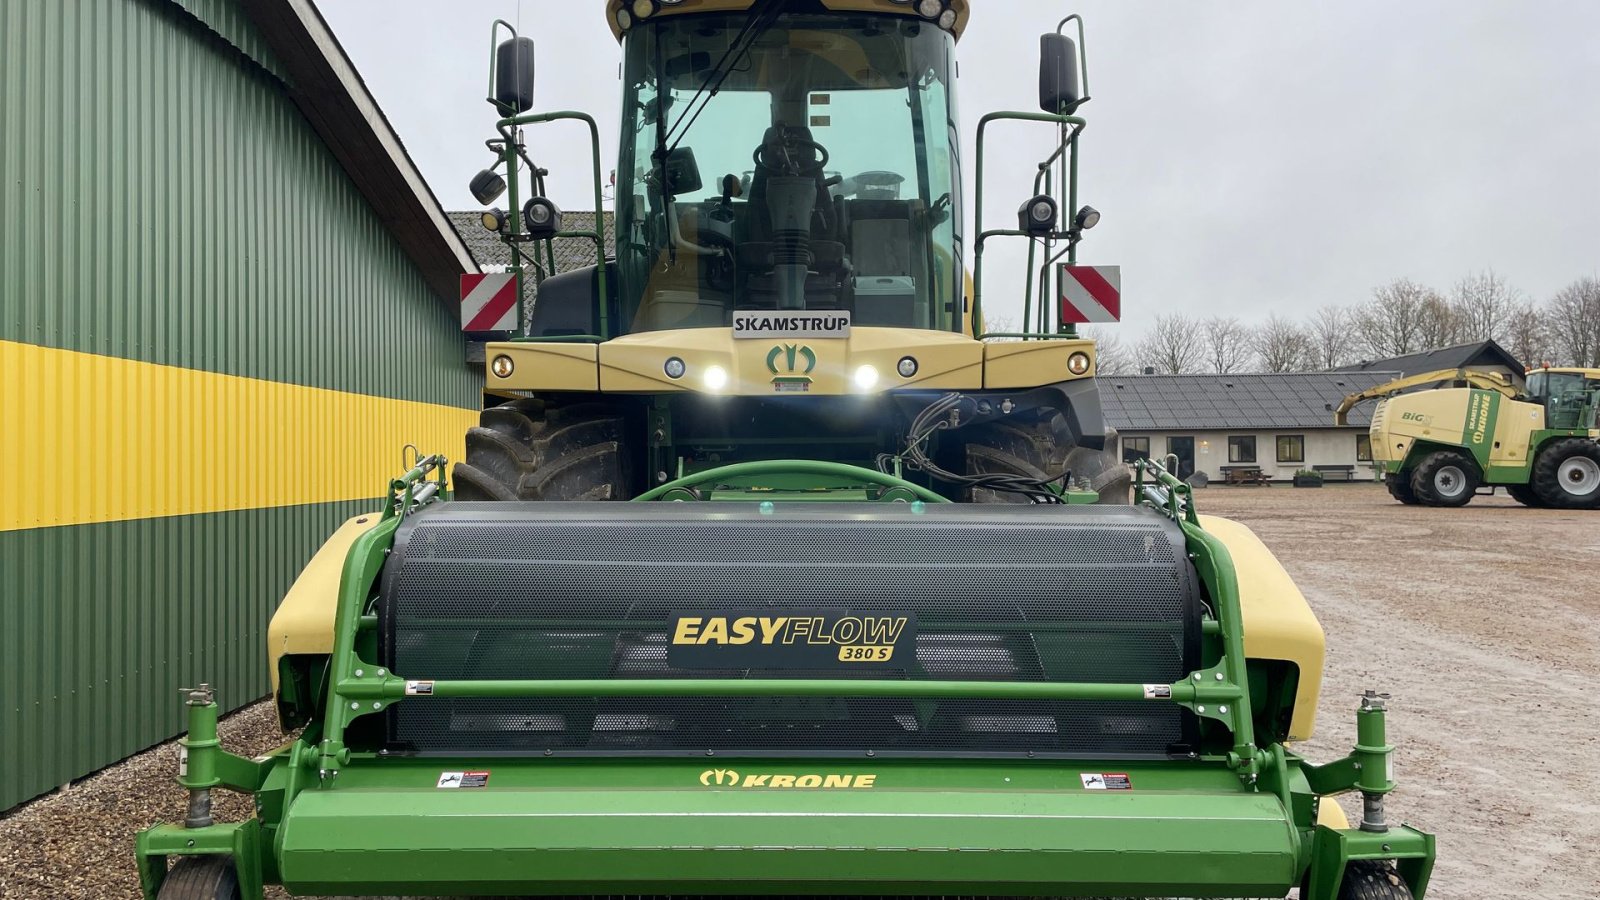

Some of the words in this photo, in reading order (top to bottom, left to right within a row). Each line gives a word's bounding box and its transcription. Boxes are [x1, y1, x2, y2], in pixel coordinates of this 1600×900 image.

[735, 318, 848, 331] SKAMSTRUP
[1477, 394, 1490, 433] KRONE
[672, 617, 907, 645] EASYFLOW
[844, 648, 873, 659] 380
[878, 648, 888, 659] S
[742, 774, 877, 788] KRONE
